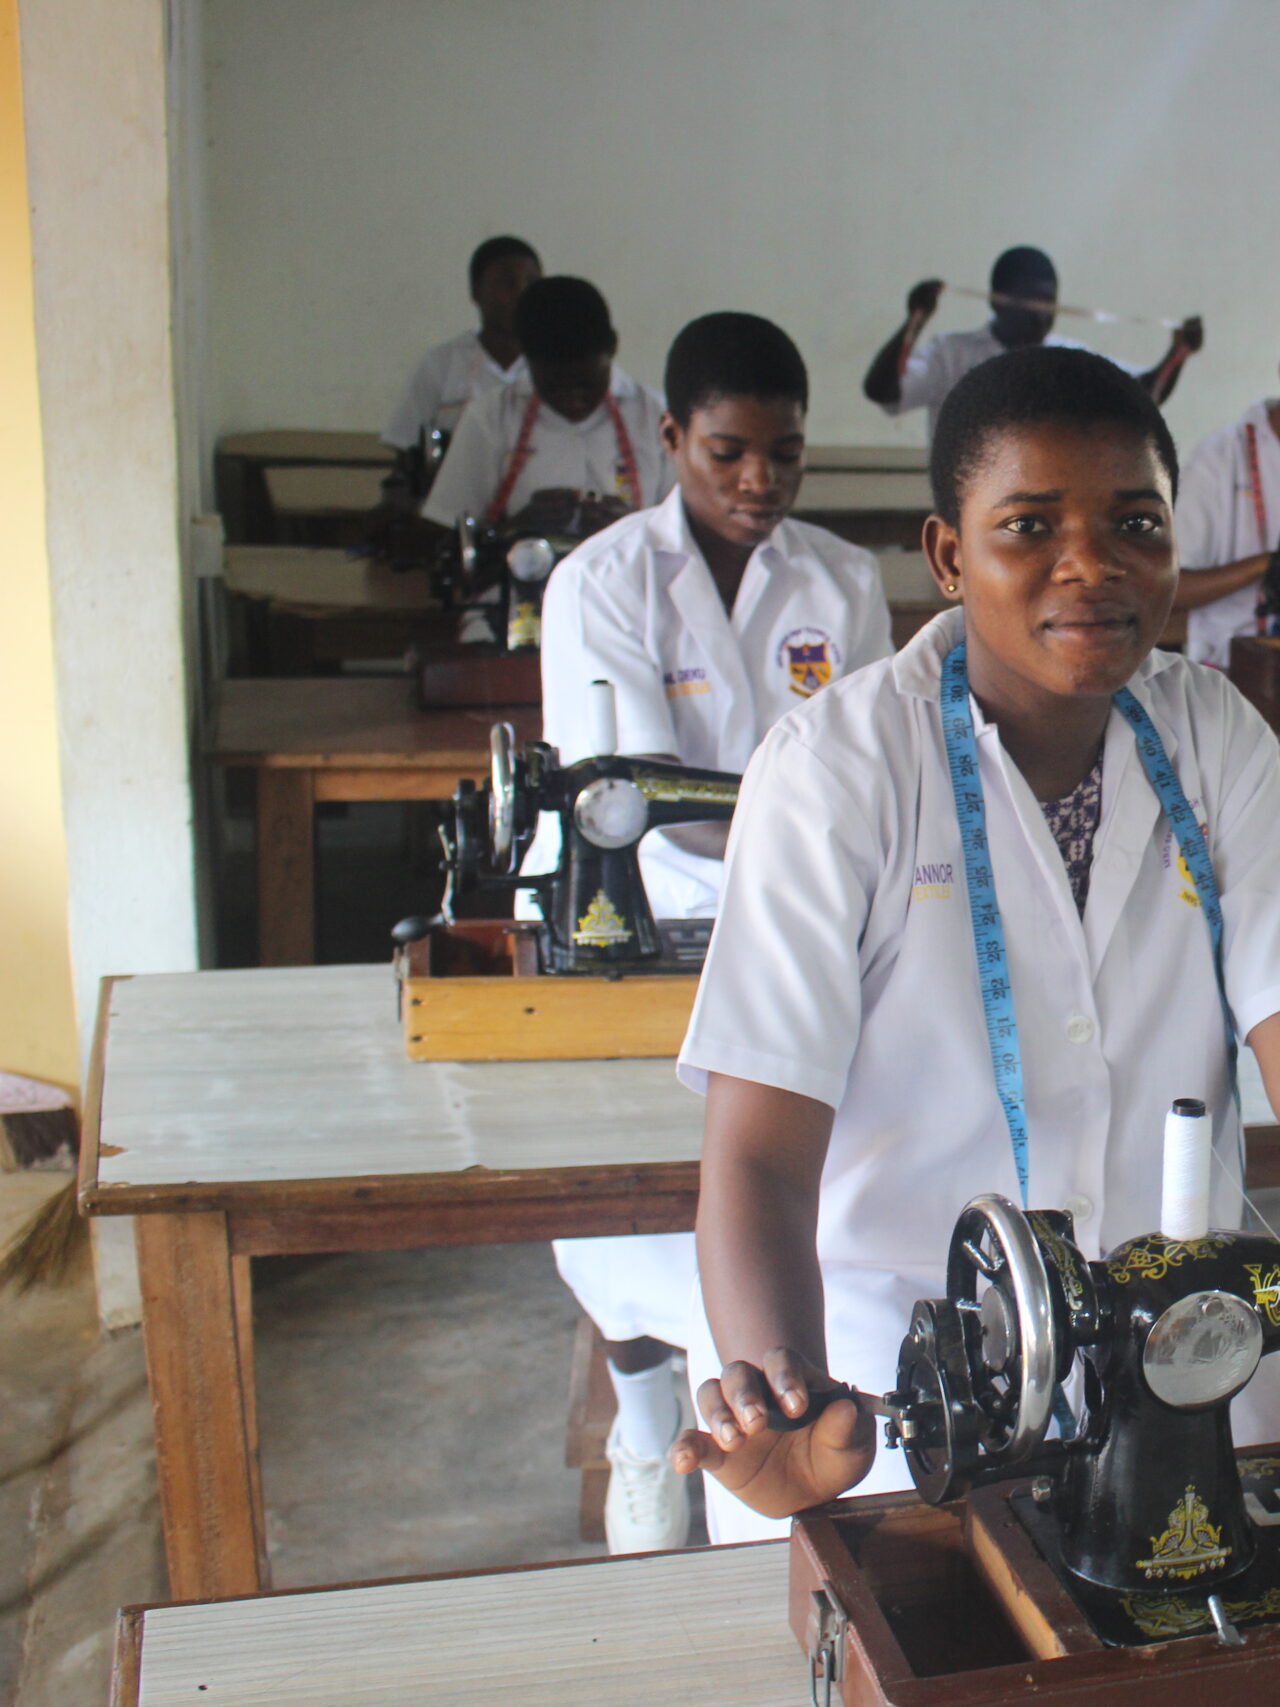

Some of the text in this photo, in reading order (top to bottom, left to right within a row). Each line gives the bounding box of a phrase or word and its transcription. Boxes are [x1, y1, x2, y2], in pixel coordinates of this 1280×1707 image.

[950, 685, 964, 703] 30
[952, 718, 967, 740] 29
[1142, 736, 1157, 757] 40
[959, 754, 974, 776] 28
[1154, 769, 1171, 788] 41
[965, 793, 980, 813] 27
[1169, 802, 1186, 824] 42
[971, 828, 984, 850] 26
[914, 863, 954, 886] ANNOR
[975, 866, 989, 888] 25
[980, 903, 996, 925] 24
[985, 941, 1000, 963] 23
[990, 978, 1006, 1000] 22
[996, 1016, 1011, 1037] 21
[1003, 1053, 1016, 1074] 20
